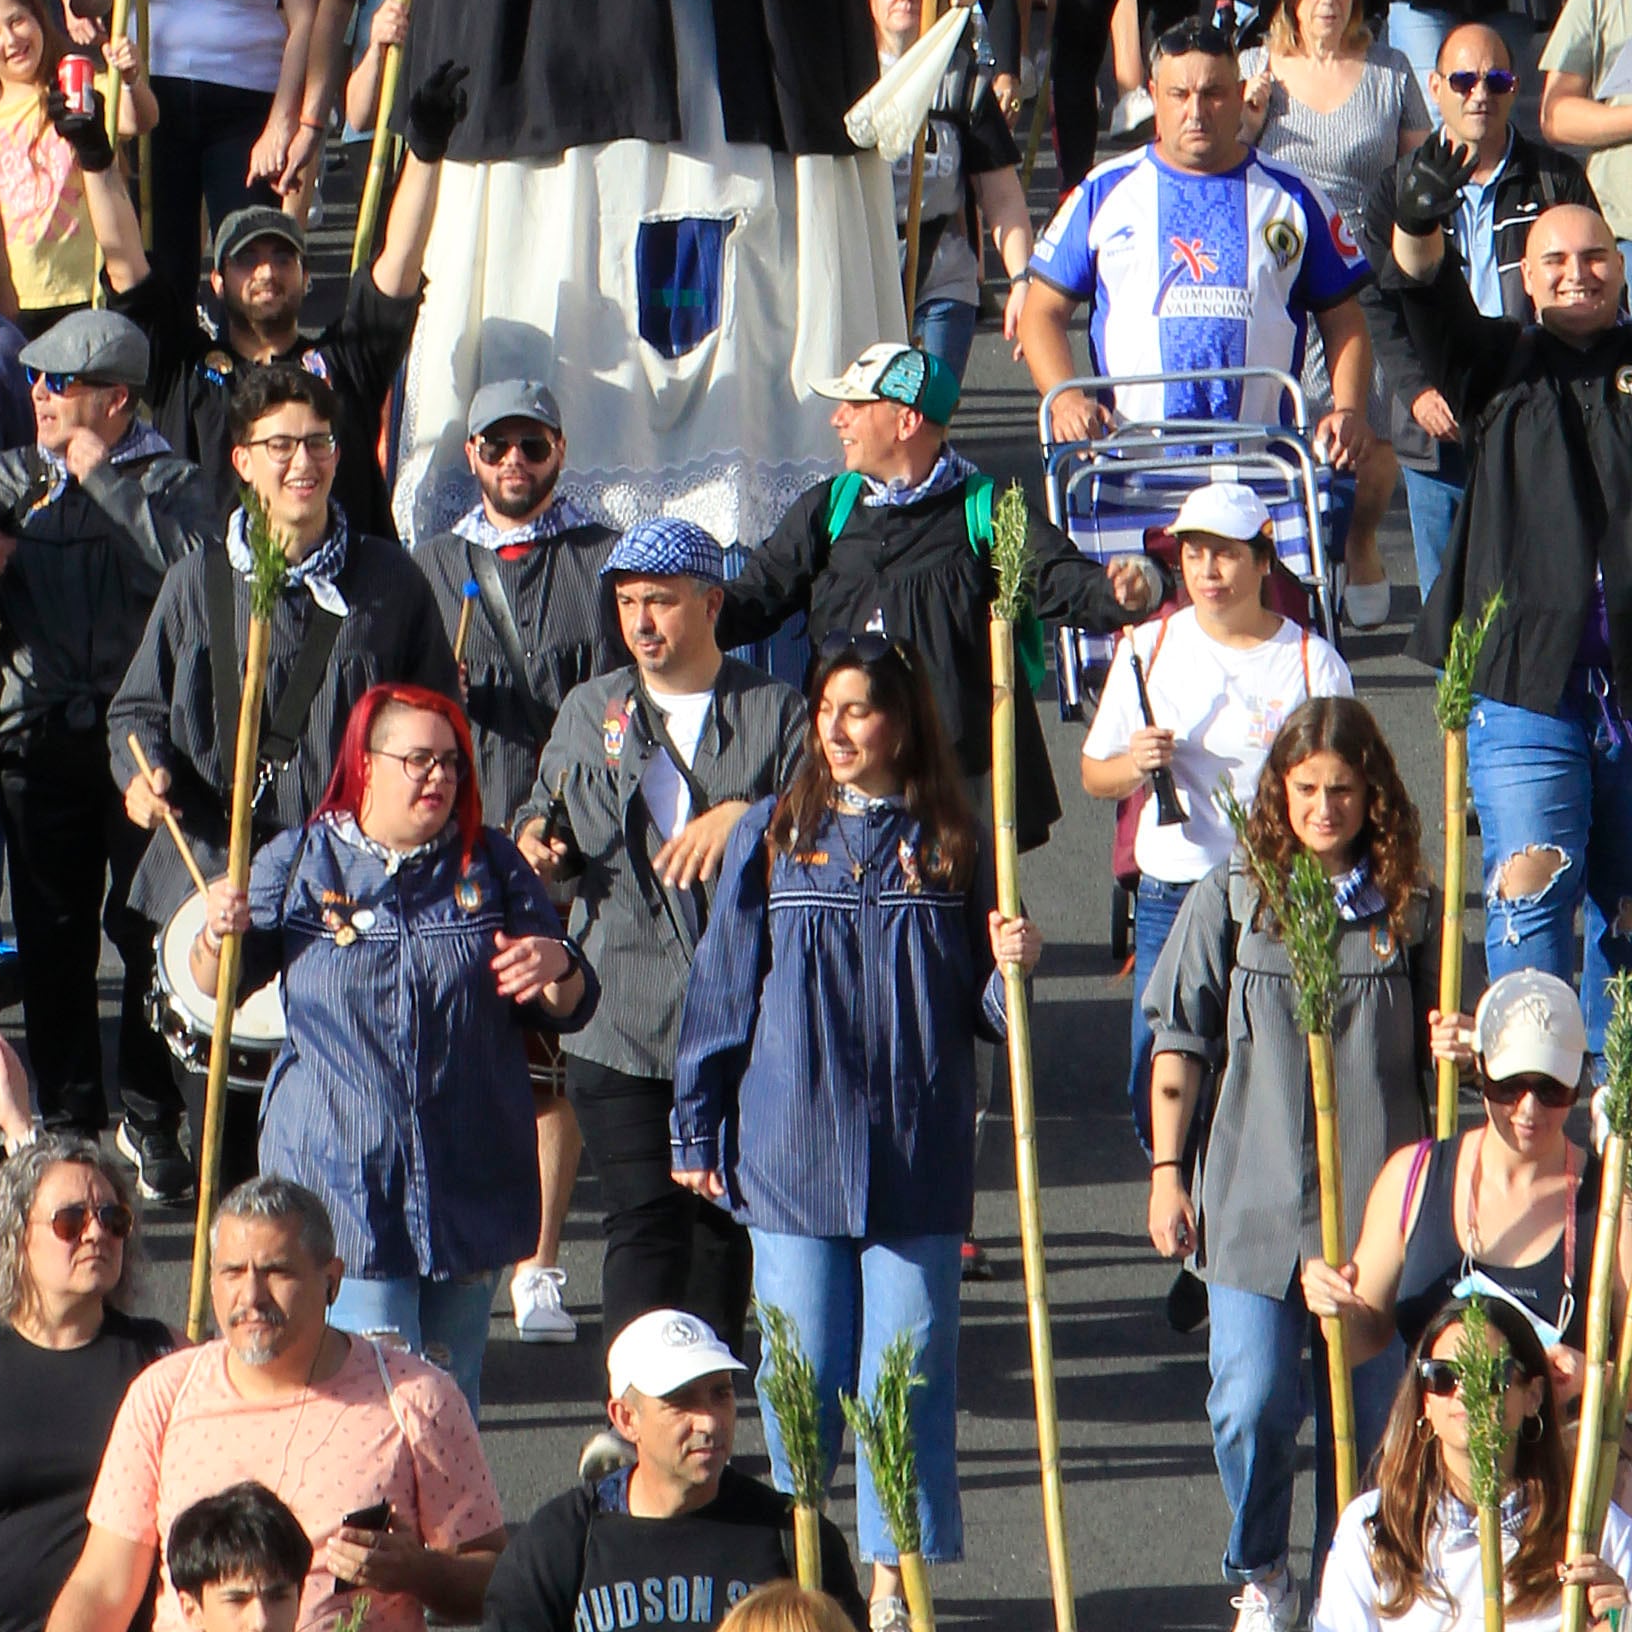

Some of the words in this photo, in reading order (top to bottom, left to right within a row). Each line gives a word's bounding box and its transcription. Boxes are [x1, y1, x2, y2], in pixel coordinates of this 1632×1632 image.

[1170, 287, 1254, 304] COMUNITAT
[1165, 302, 1255, 318] VALENCIANA
[574, 1574, 709, 1632] HUDSON
